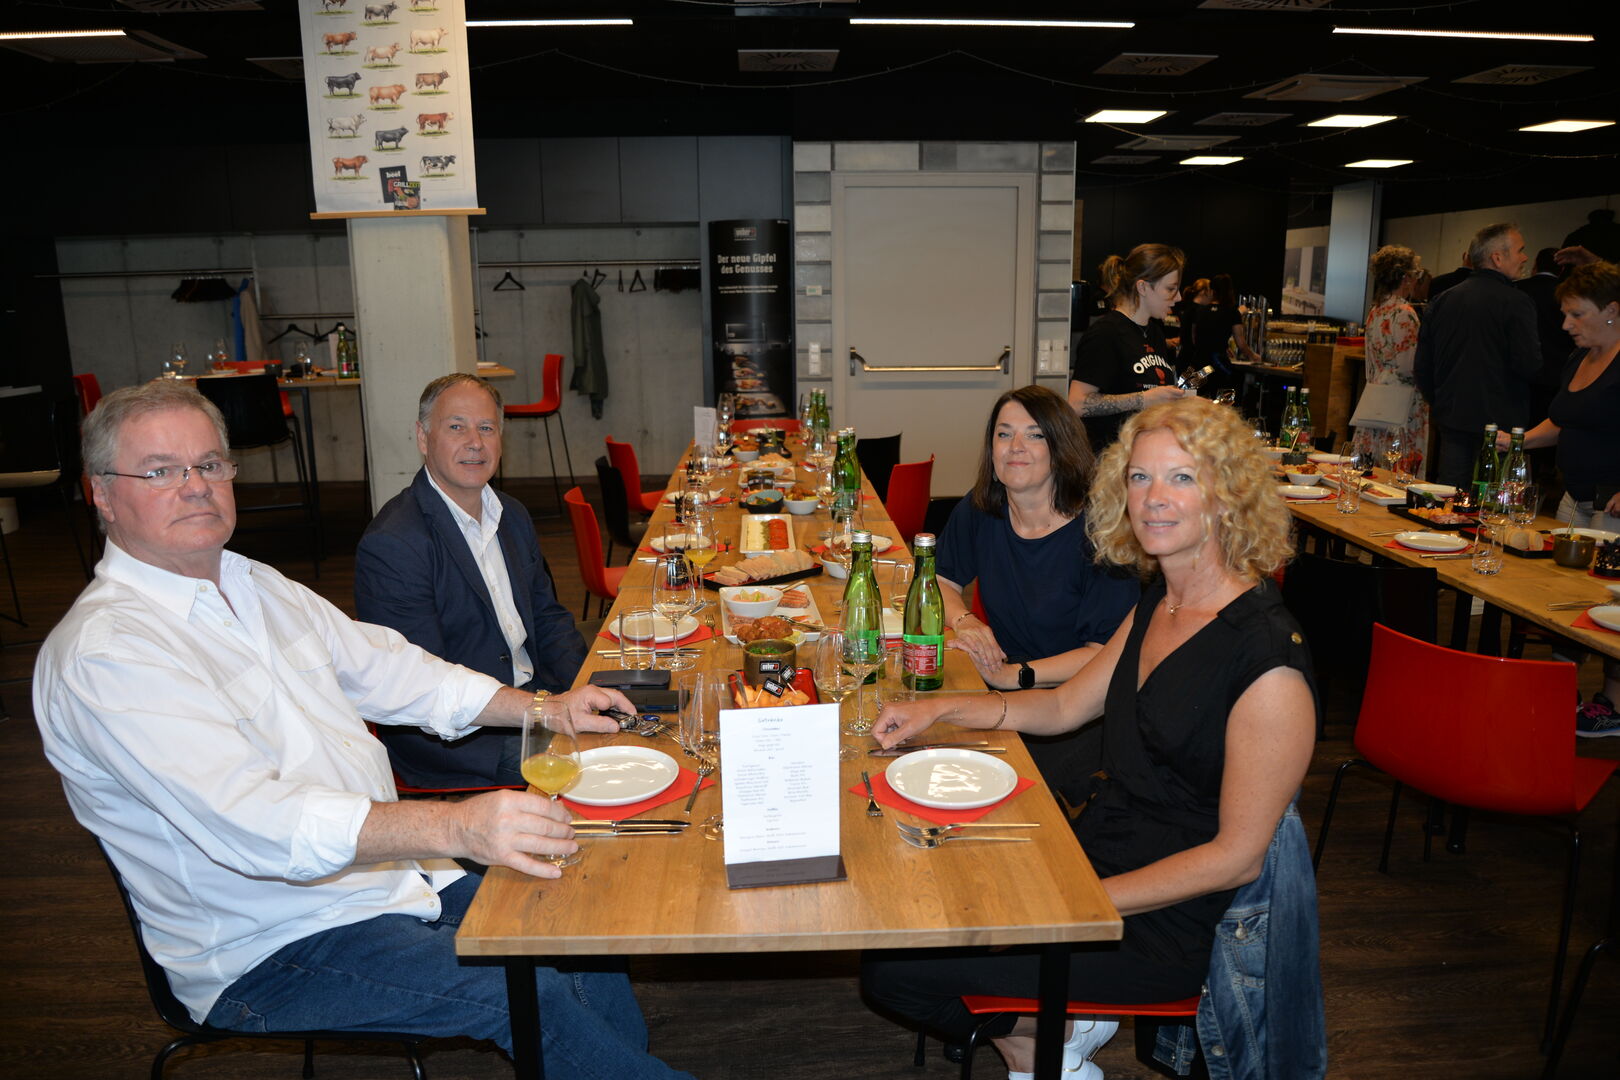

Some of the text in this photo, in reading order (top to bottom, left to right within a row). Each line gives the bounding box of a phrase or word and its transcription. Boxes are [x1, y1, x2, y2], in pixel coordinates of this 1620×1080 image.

[717, 253, 776, 264] Der neue Gipfel
[721, 265, 773, 274] des Genusses
